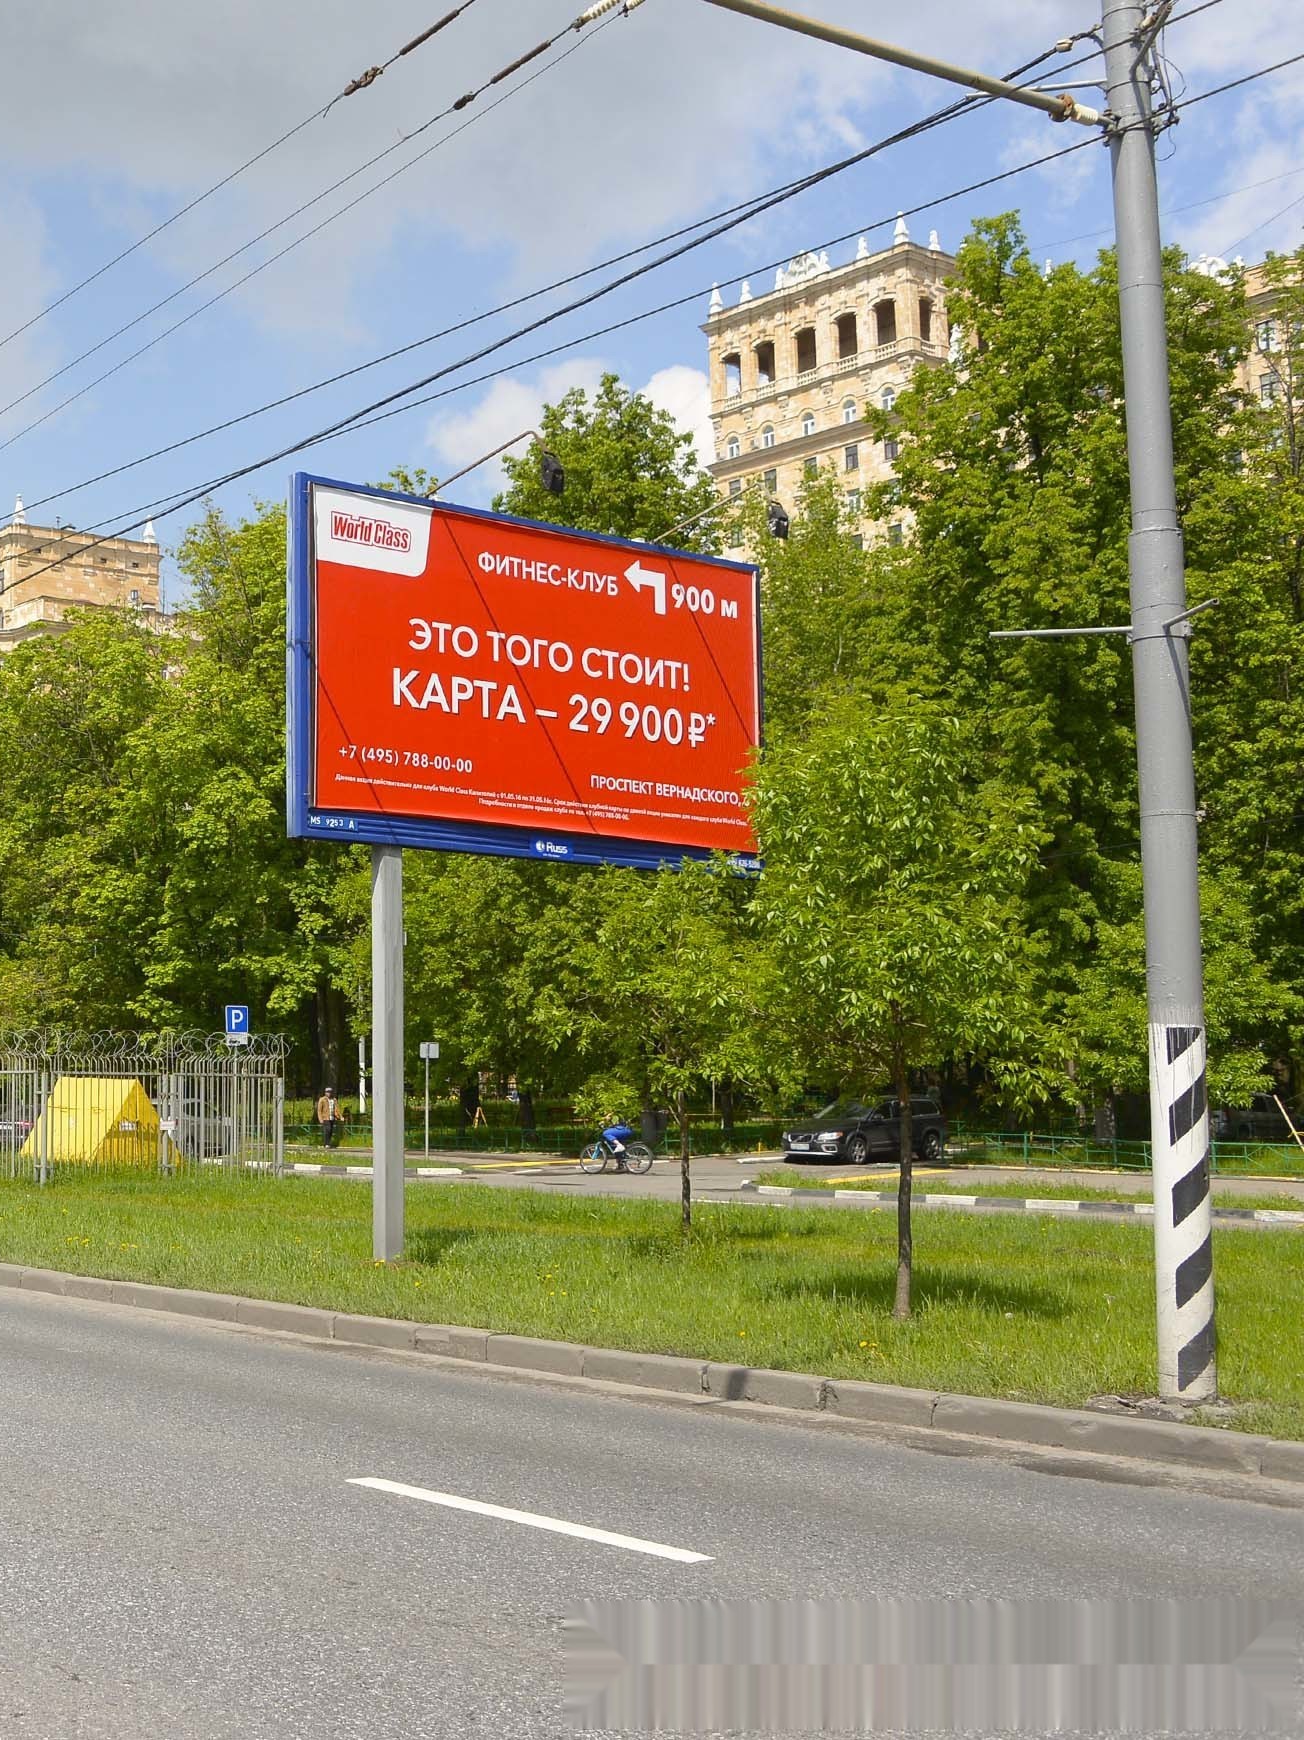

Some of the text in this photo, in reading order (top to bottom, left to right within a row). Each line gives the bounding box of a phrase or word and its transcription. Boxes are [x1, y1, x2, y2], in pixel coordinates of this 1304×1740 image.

[333, 514, 410, 550] World Class
[477, 551, 738, 619] ФИТНЕС-КЛУБ 900 м
[408, 617, 691, 693] ЭТО ТОГО СТОИТ!
[392, 667, 527, 724] КАРТА
[338, 744, 474, 774] +7 (495) 788-00-00
[590, 774, 655, 796] ПРОСПЕКТ
[655, 783, 742, 808] ВЕРНАДСКОГО,
[310, 815, 321, 825] MS
[546, 841, 568, 854] Russ
[231, 1009, 244, 1030] P
